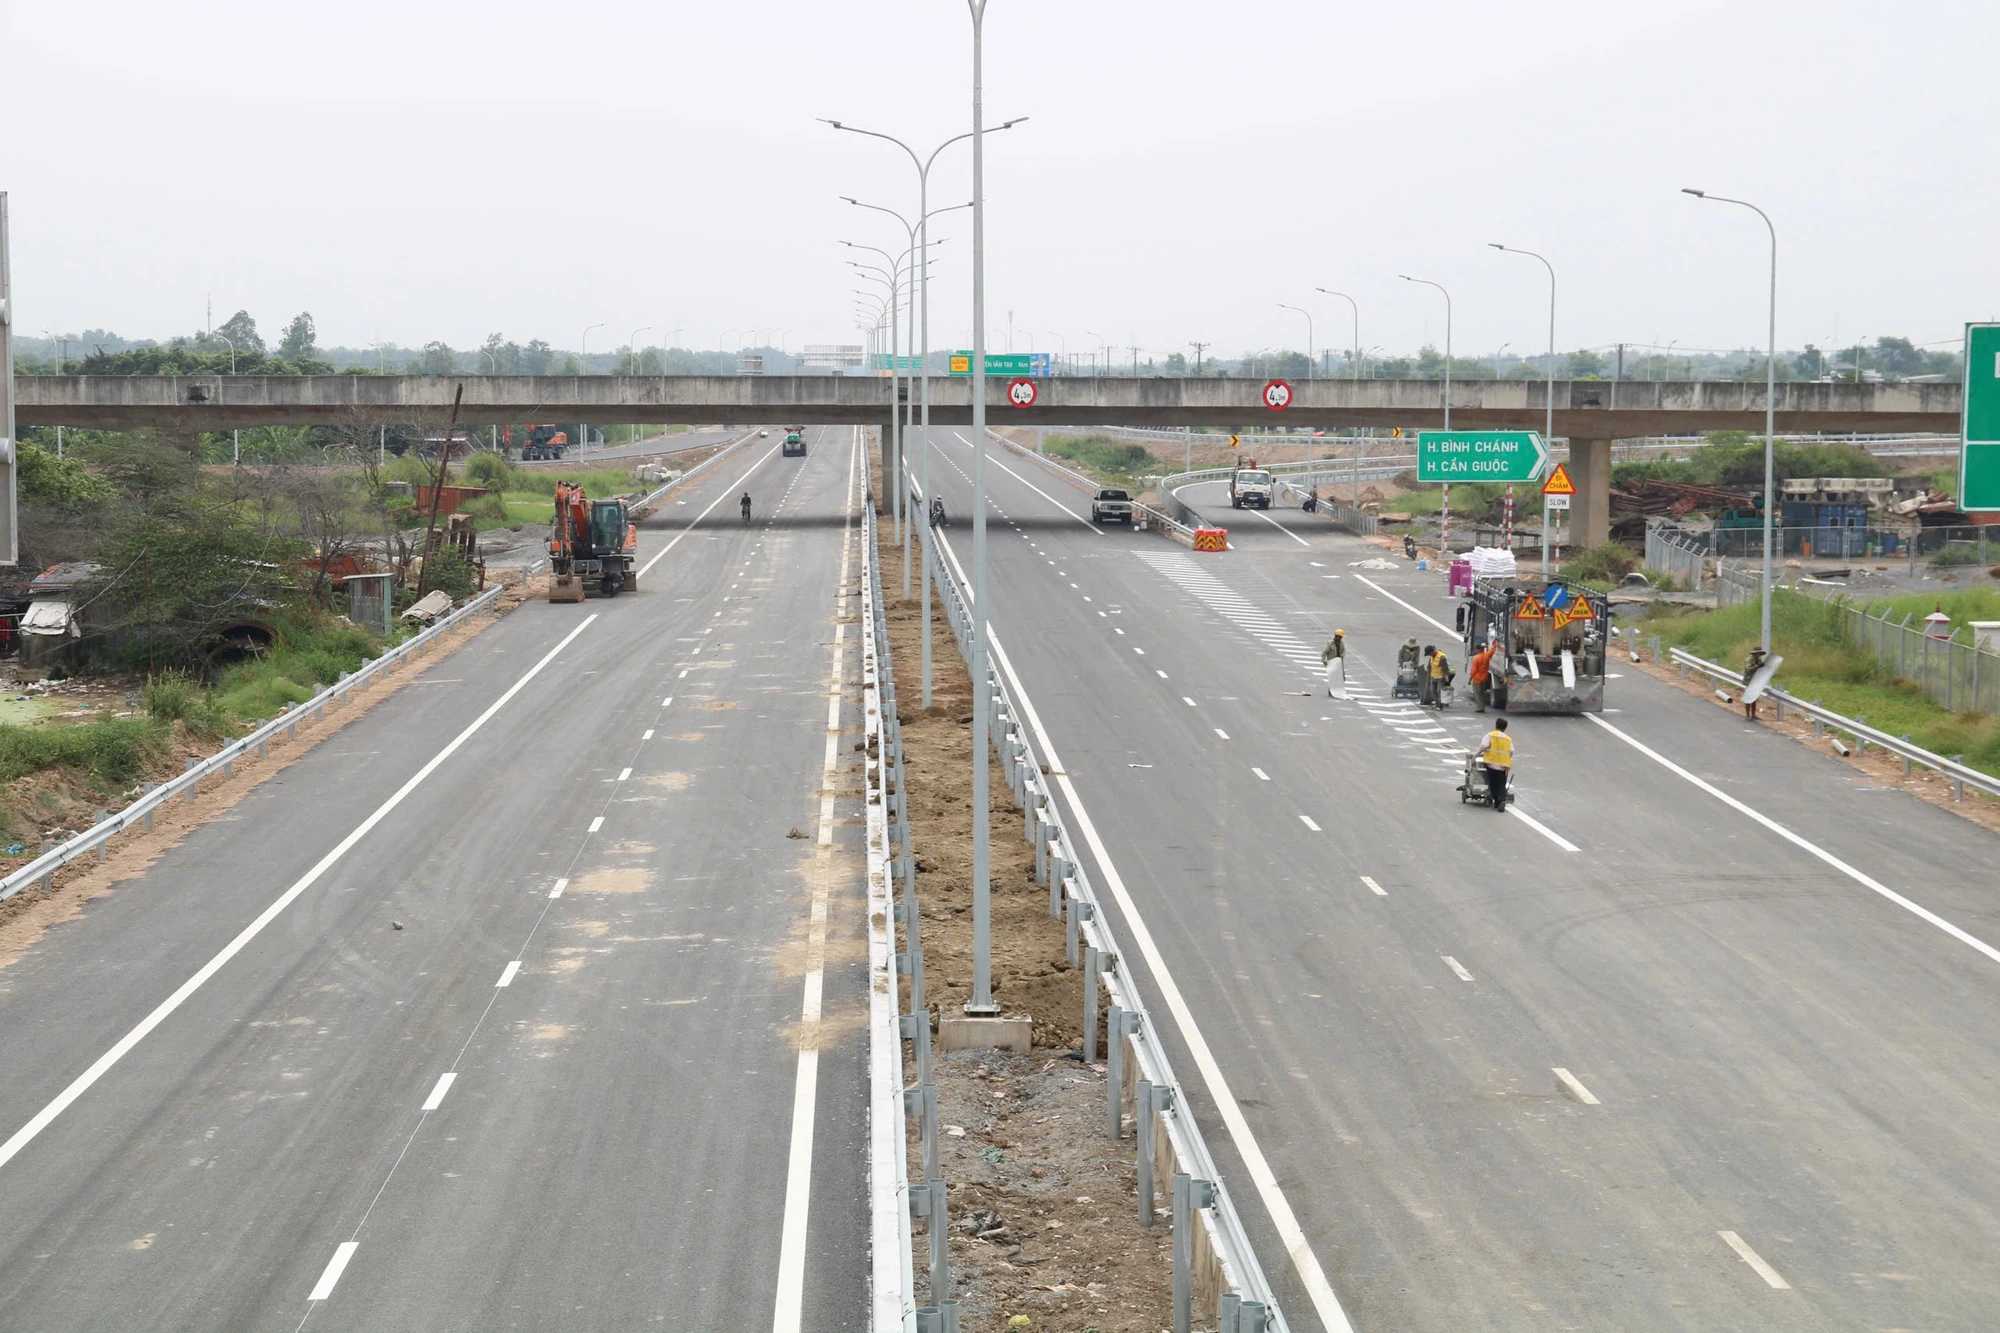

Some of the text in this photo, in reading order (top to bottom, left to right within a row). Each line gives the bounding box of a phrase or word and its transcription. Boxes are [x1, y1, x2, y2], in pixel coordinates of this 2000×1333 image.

[1427, 439, 1519, 453] H. BÌNH CHÁNH
[1427, 461, 1439, 472] H.
[1472, 458, 1509, 474] GIUỘC
[1548, 498, 1568, 506] SLOW
